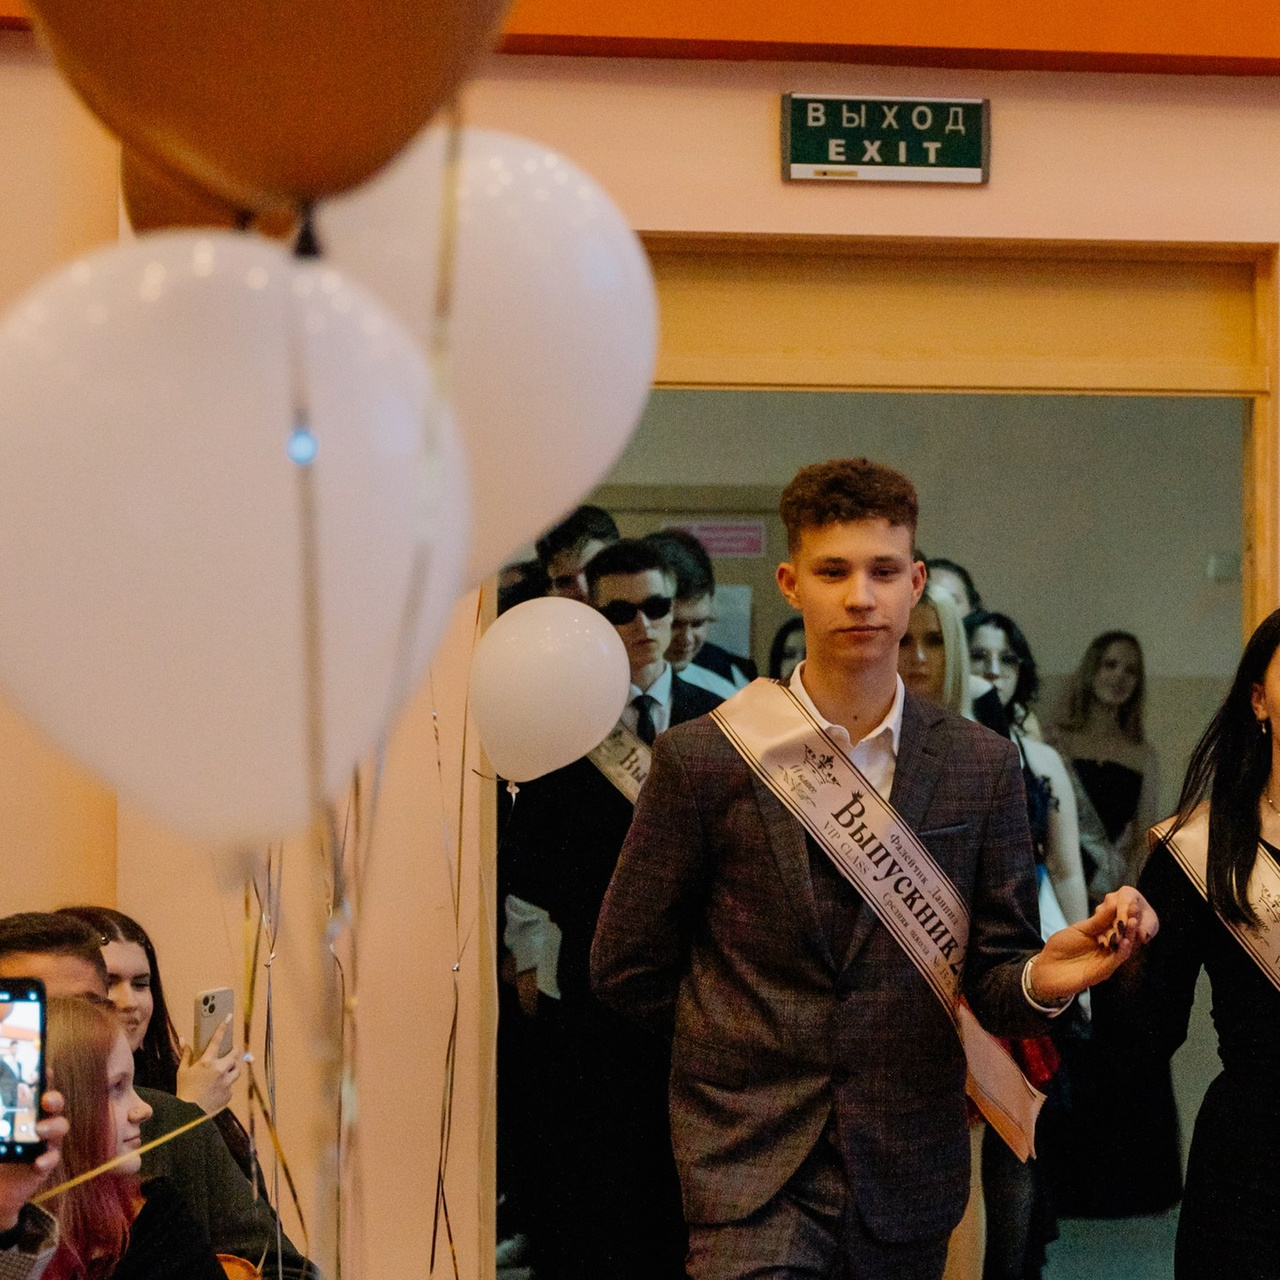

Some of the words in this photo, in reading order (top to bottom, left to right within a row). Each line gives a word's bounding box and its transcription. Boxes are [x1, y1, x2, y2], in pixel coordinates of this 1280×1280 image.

[806, 102, 966, 136] ВЫХОД
[828, 138, 942, 164] EXIT
[823, 821, 841, 840] VIP
[840, 842, 870, 875] CLASS
[830, 796, 959, 961] Выпускник
[882, 892, 910, 929] Средняя
[909, 929, 931, 956] школа
